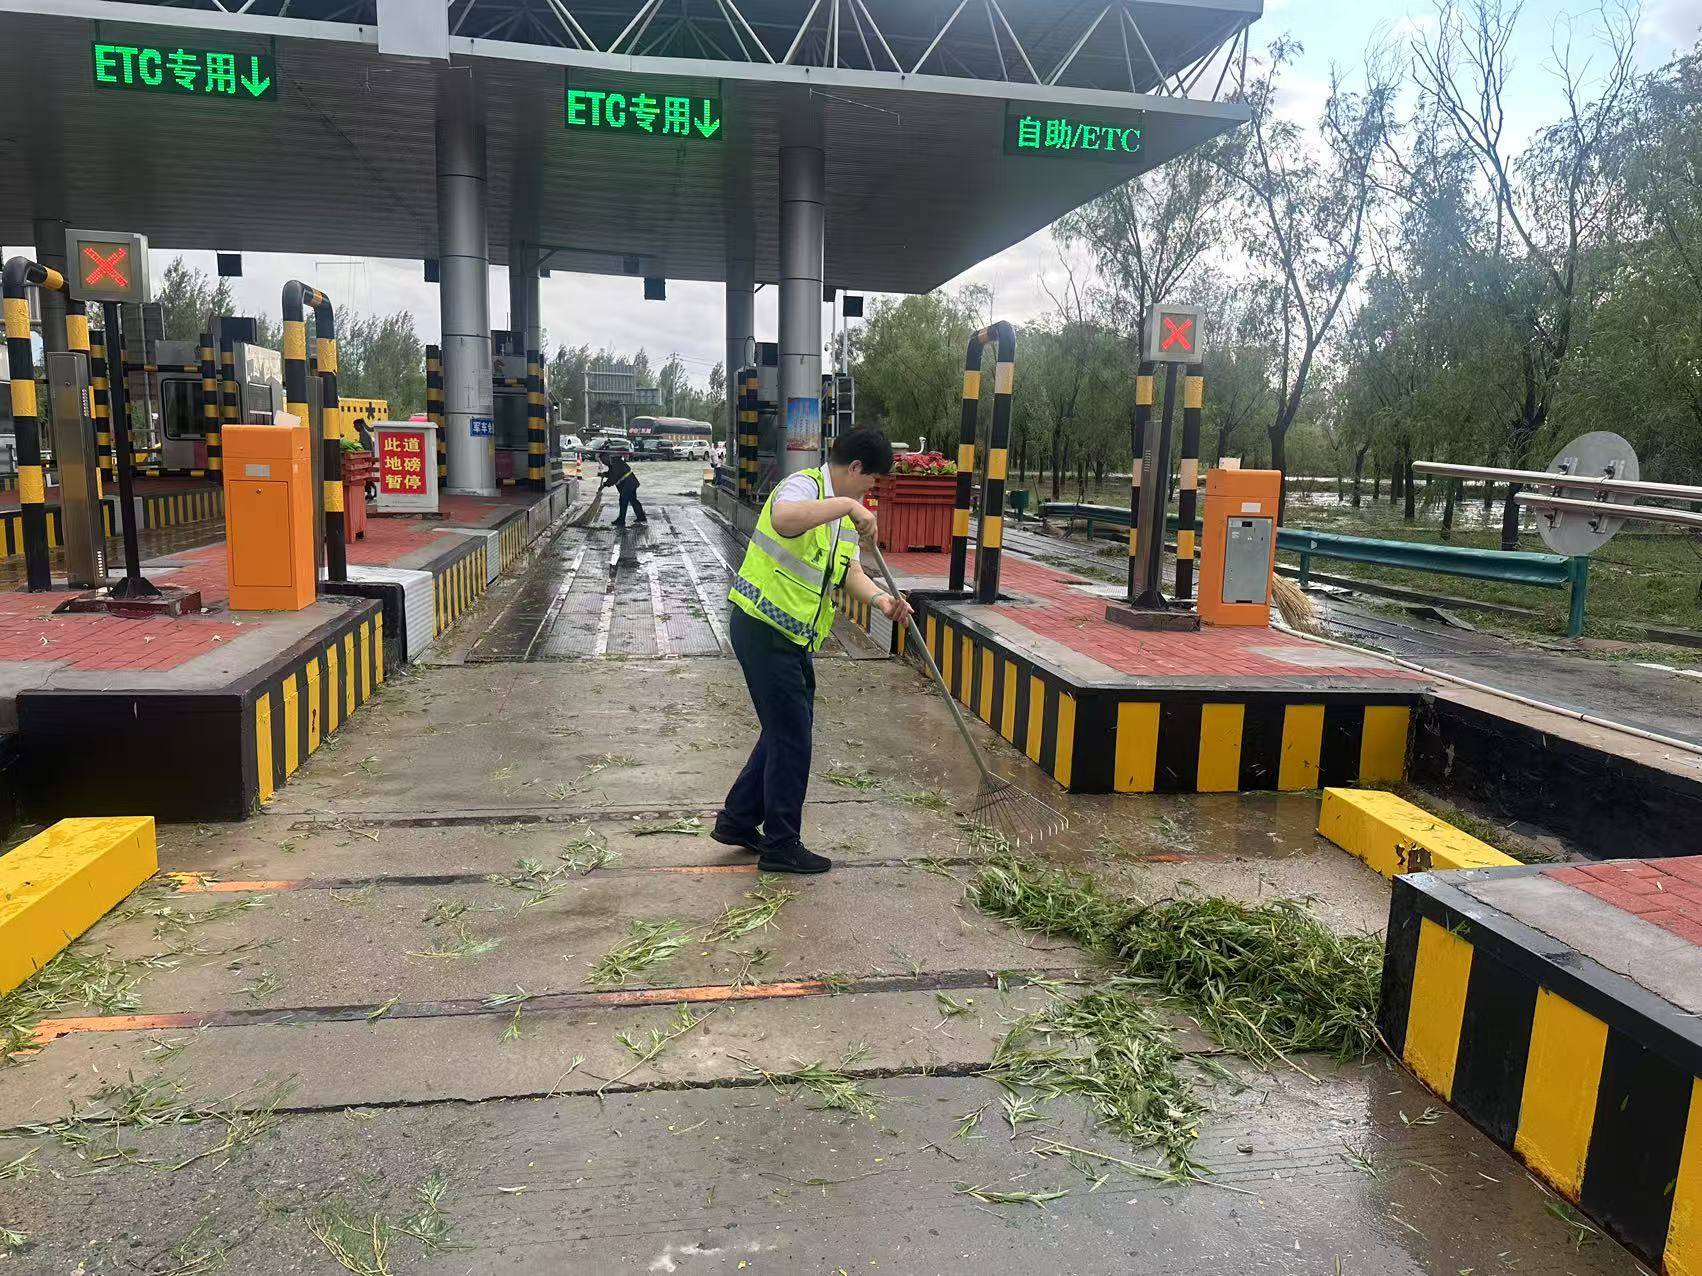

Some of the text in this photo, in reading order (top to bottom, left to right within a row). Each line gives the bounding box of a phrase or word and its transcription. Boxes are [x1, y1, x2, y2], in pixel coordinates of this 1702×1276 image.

[94, 44, 236, 94] ETC专用
[567, 89, 690, 136] ETC专用
[1018, 116, 1141, 153] 自助/ETC
[384, 437, 421, 453] 此道
[384, 455, 422, 472] 地磅
[385, 474, 422, 490] 暂停
